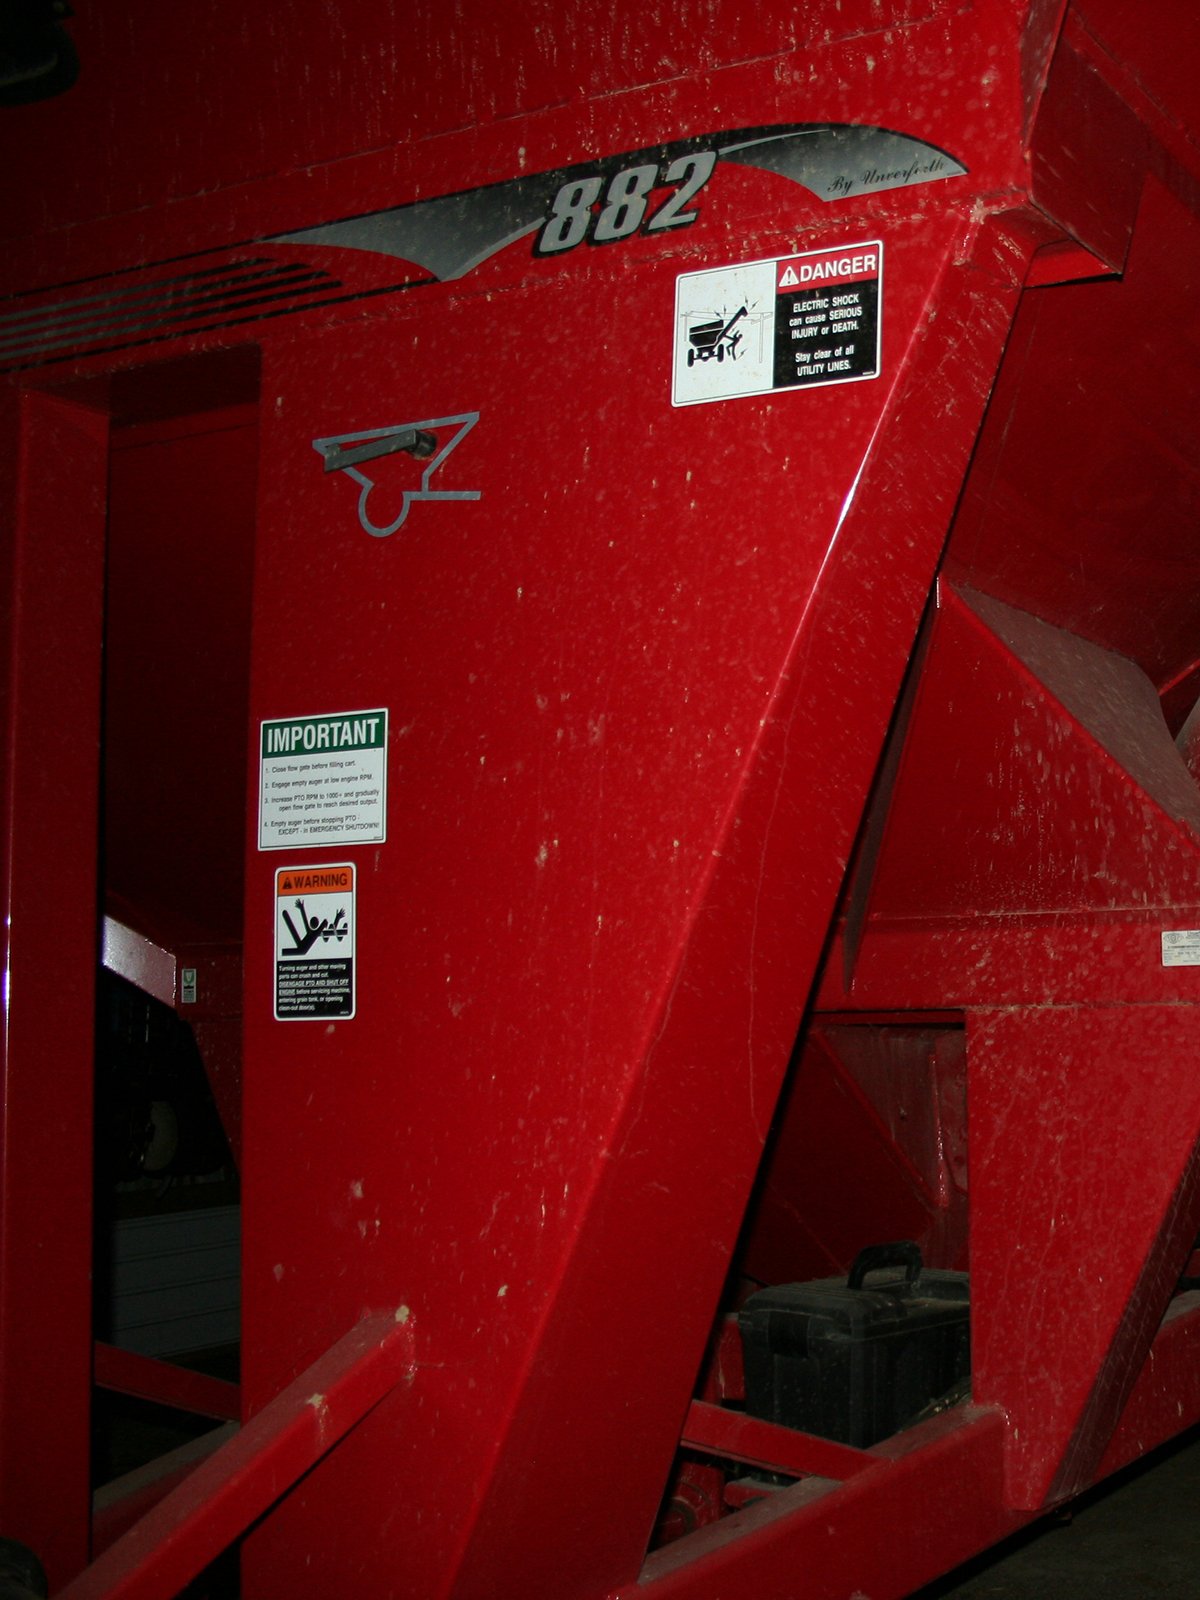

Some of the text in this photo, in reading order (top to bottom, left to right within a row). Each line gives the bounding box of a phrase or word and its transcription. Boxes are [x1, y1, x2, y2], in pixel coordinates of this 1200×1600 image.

[827, 176, 852, 196] By
[535, 150, 719, 253] 882
[800, 254, 876, 282] DANGER
[793, 293, 859, 313] ELECTRIC SHOCK
[789, 306, 863, 327] can cause SERIOUS
[791, 320, 859, 340] INJURY or DEATH.
[795, 344, 855, 363] Stay clear of all
[797, 360, 852, 377] UTILITY LINES.
[267, 718, 380, 753] IMPORTANT
[312, 762, 328, 770] before
[330, 761, 344, 769] filling
[272, 781, 290, 789] Engage
[355, 789, 379, 798] gradually
[339, 799, 359, 807] desired
[271, 820, 286, 828] Empty
[310, 825, 344, 833] EMERGENCY
[294, 872, 348, 889] WARNING
[279, 965, 295, 973] Turning
